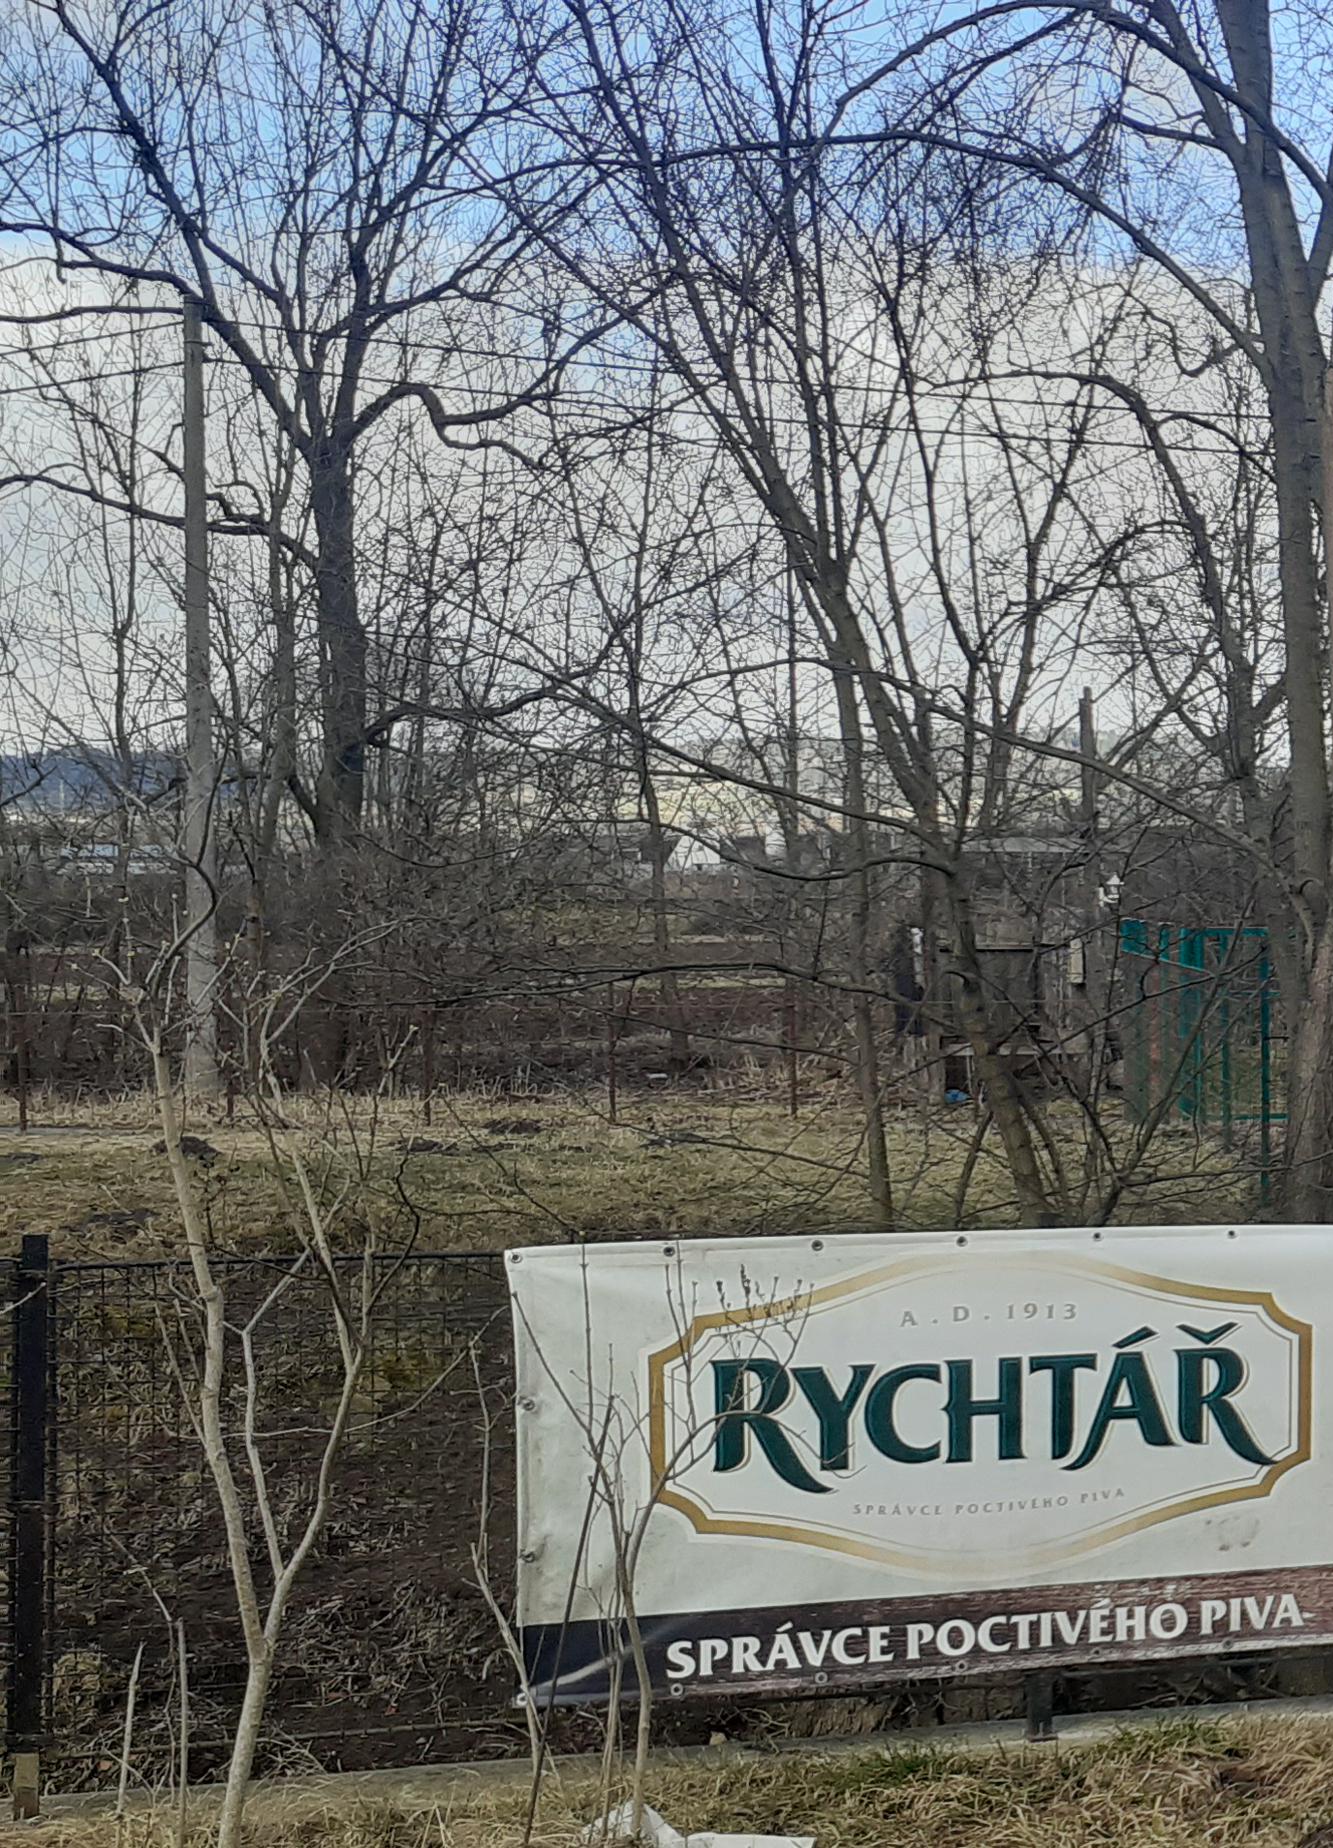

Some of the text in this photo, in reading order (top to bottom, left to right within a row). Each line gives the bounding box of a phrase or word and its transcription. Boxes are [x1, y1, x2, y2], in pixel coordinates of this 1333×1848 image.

[1007, 1302, 1077, 1320] 1913
[711, 1322, 1280, 1495] RYCHTÁŘ
[1080, 1487, 1125, 1504] PIVA
[665, 1593, 1305, 1679] SPRÁVCE POCTIVÉHO PIVA
